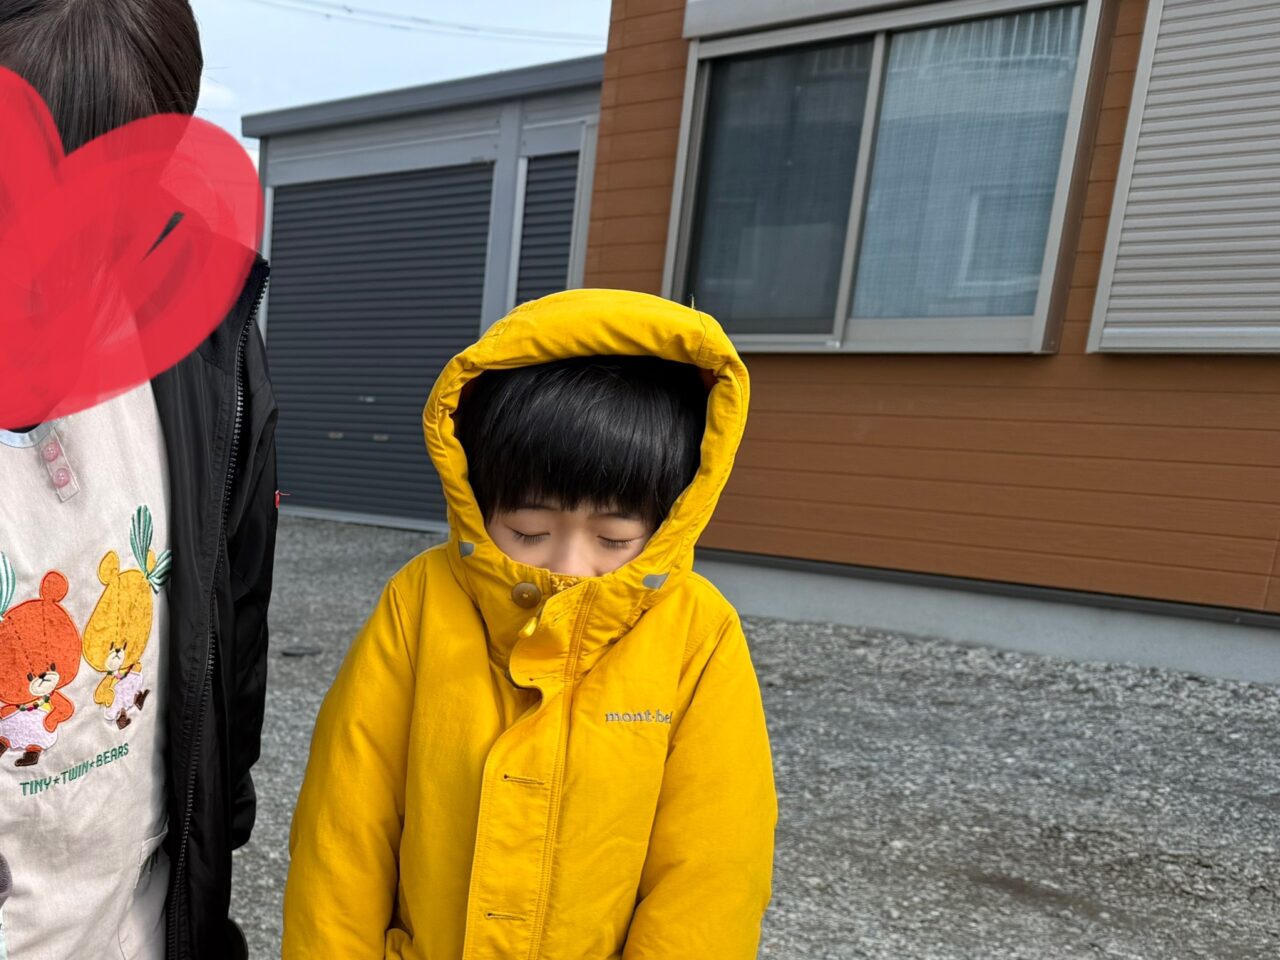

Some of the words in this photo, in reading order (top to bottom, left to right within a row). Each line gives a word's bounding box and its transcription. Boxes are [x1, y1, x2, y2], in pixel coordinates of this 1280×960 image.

[20, 775, 53, 796] TINY
[60, 760, 90, 784] TWIN
[96, 743, 129, 768] BEARS
